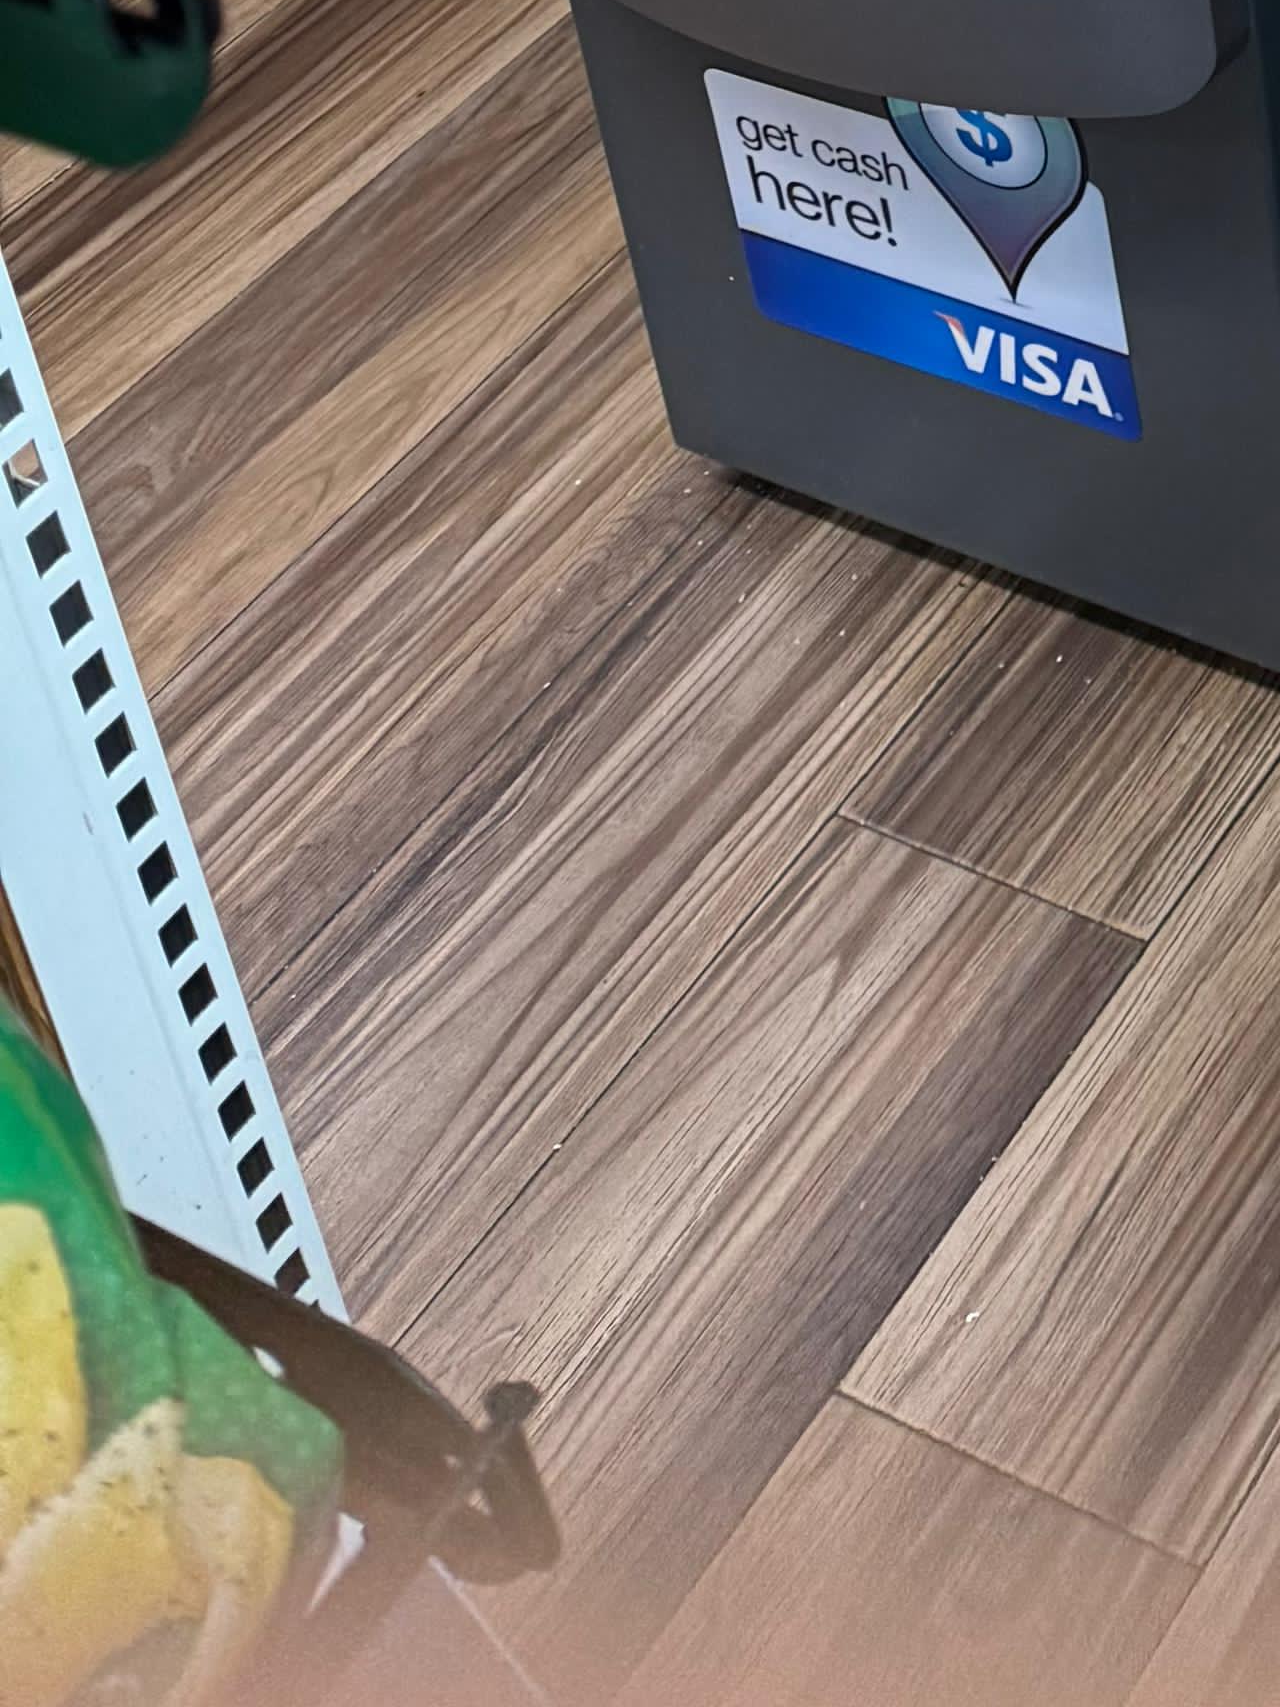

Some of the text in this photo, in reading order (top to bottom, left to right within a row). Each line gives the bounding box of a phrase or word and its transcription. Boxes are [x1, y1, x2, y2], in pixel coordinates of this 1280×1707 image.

[736, 116, 909, 190] get cash
[748, 156, 898, 247] here!
[933, 311, 1115, 420] VISA
